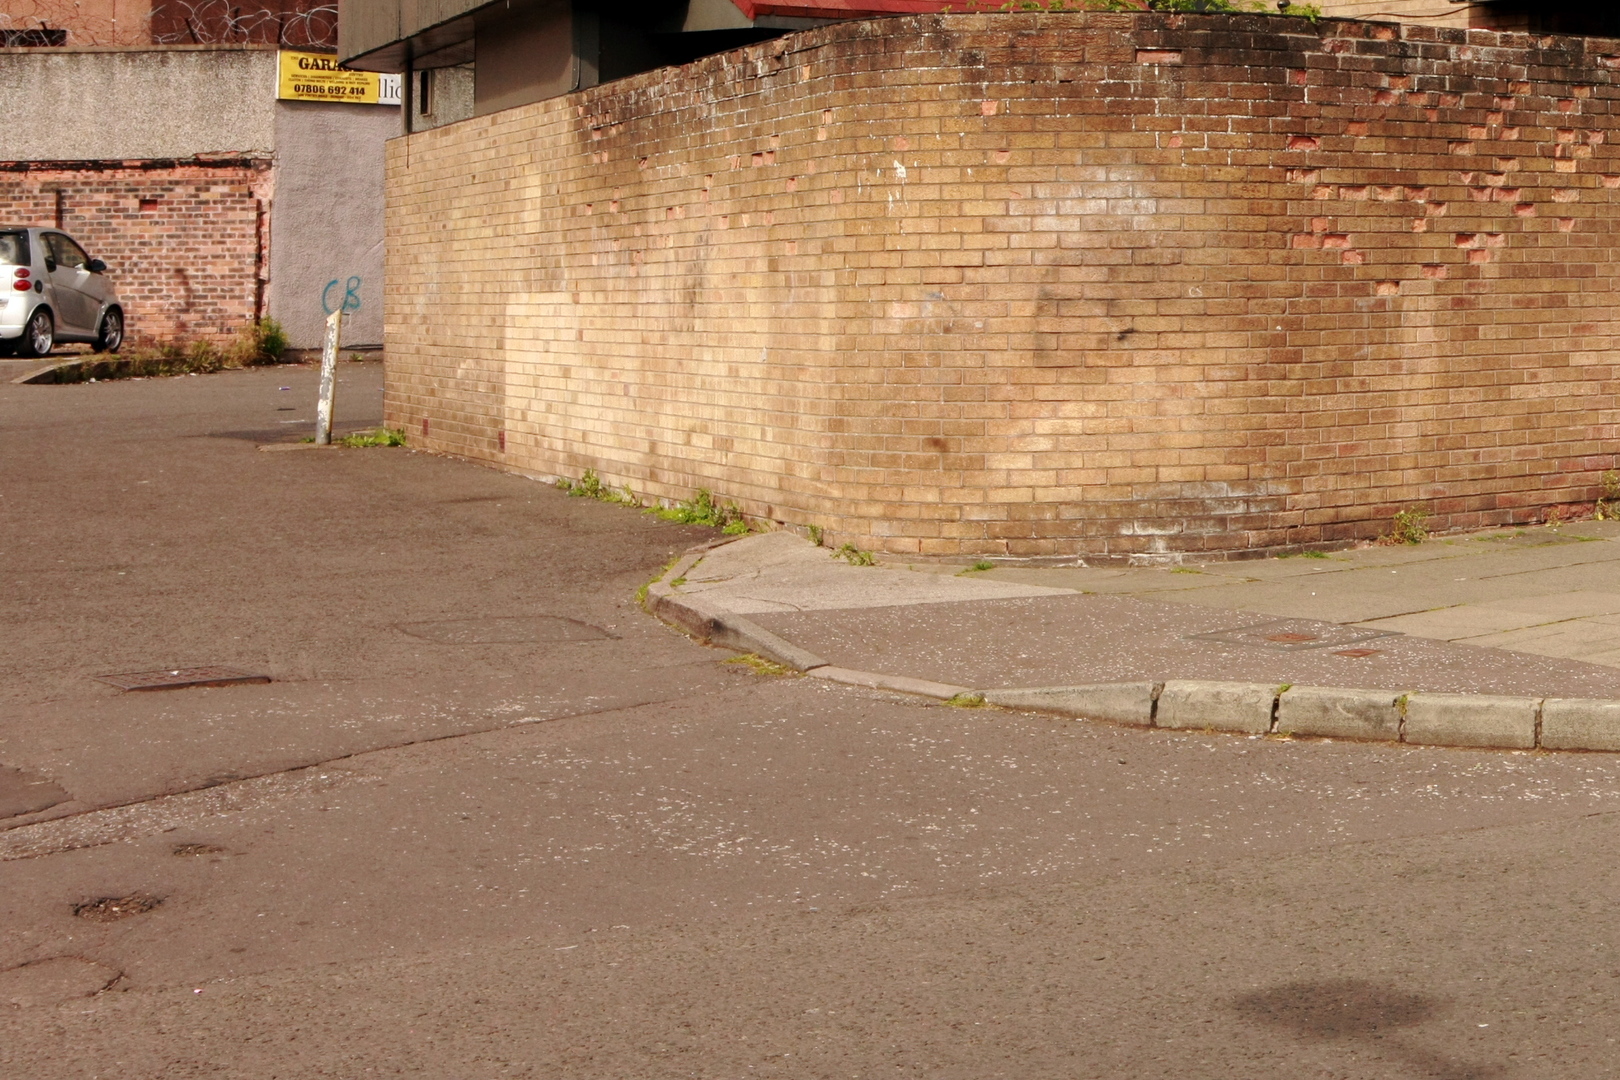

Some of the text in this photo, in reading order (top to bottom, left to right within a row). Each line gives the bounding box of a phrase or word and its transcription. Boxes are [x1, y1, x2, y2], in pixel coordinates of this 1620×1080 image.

[298, 57, 362, 72] GARA
[294, 83, 366, 96] 07806 692 414
